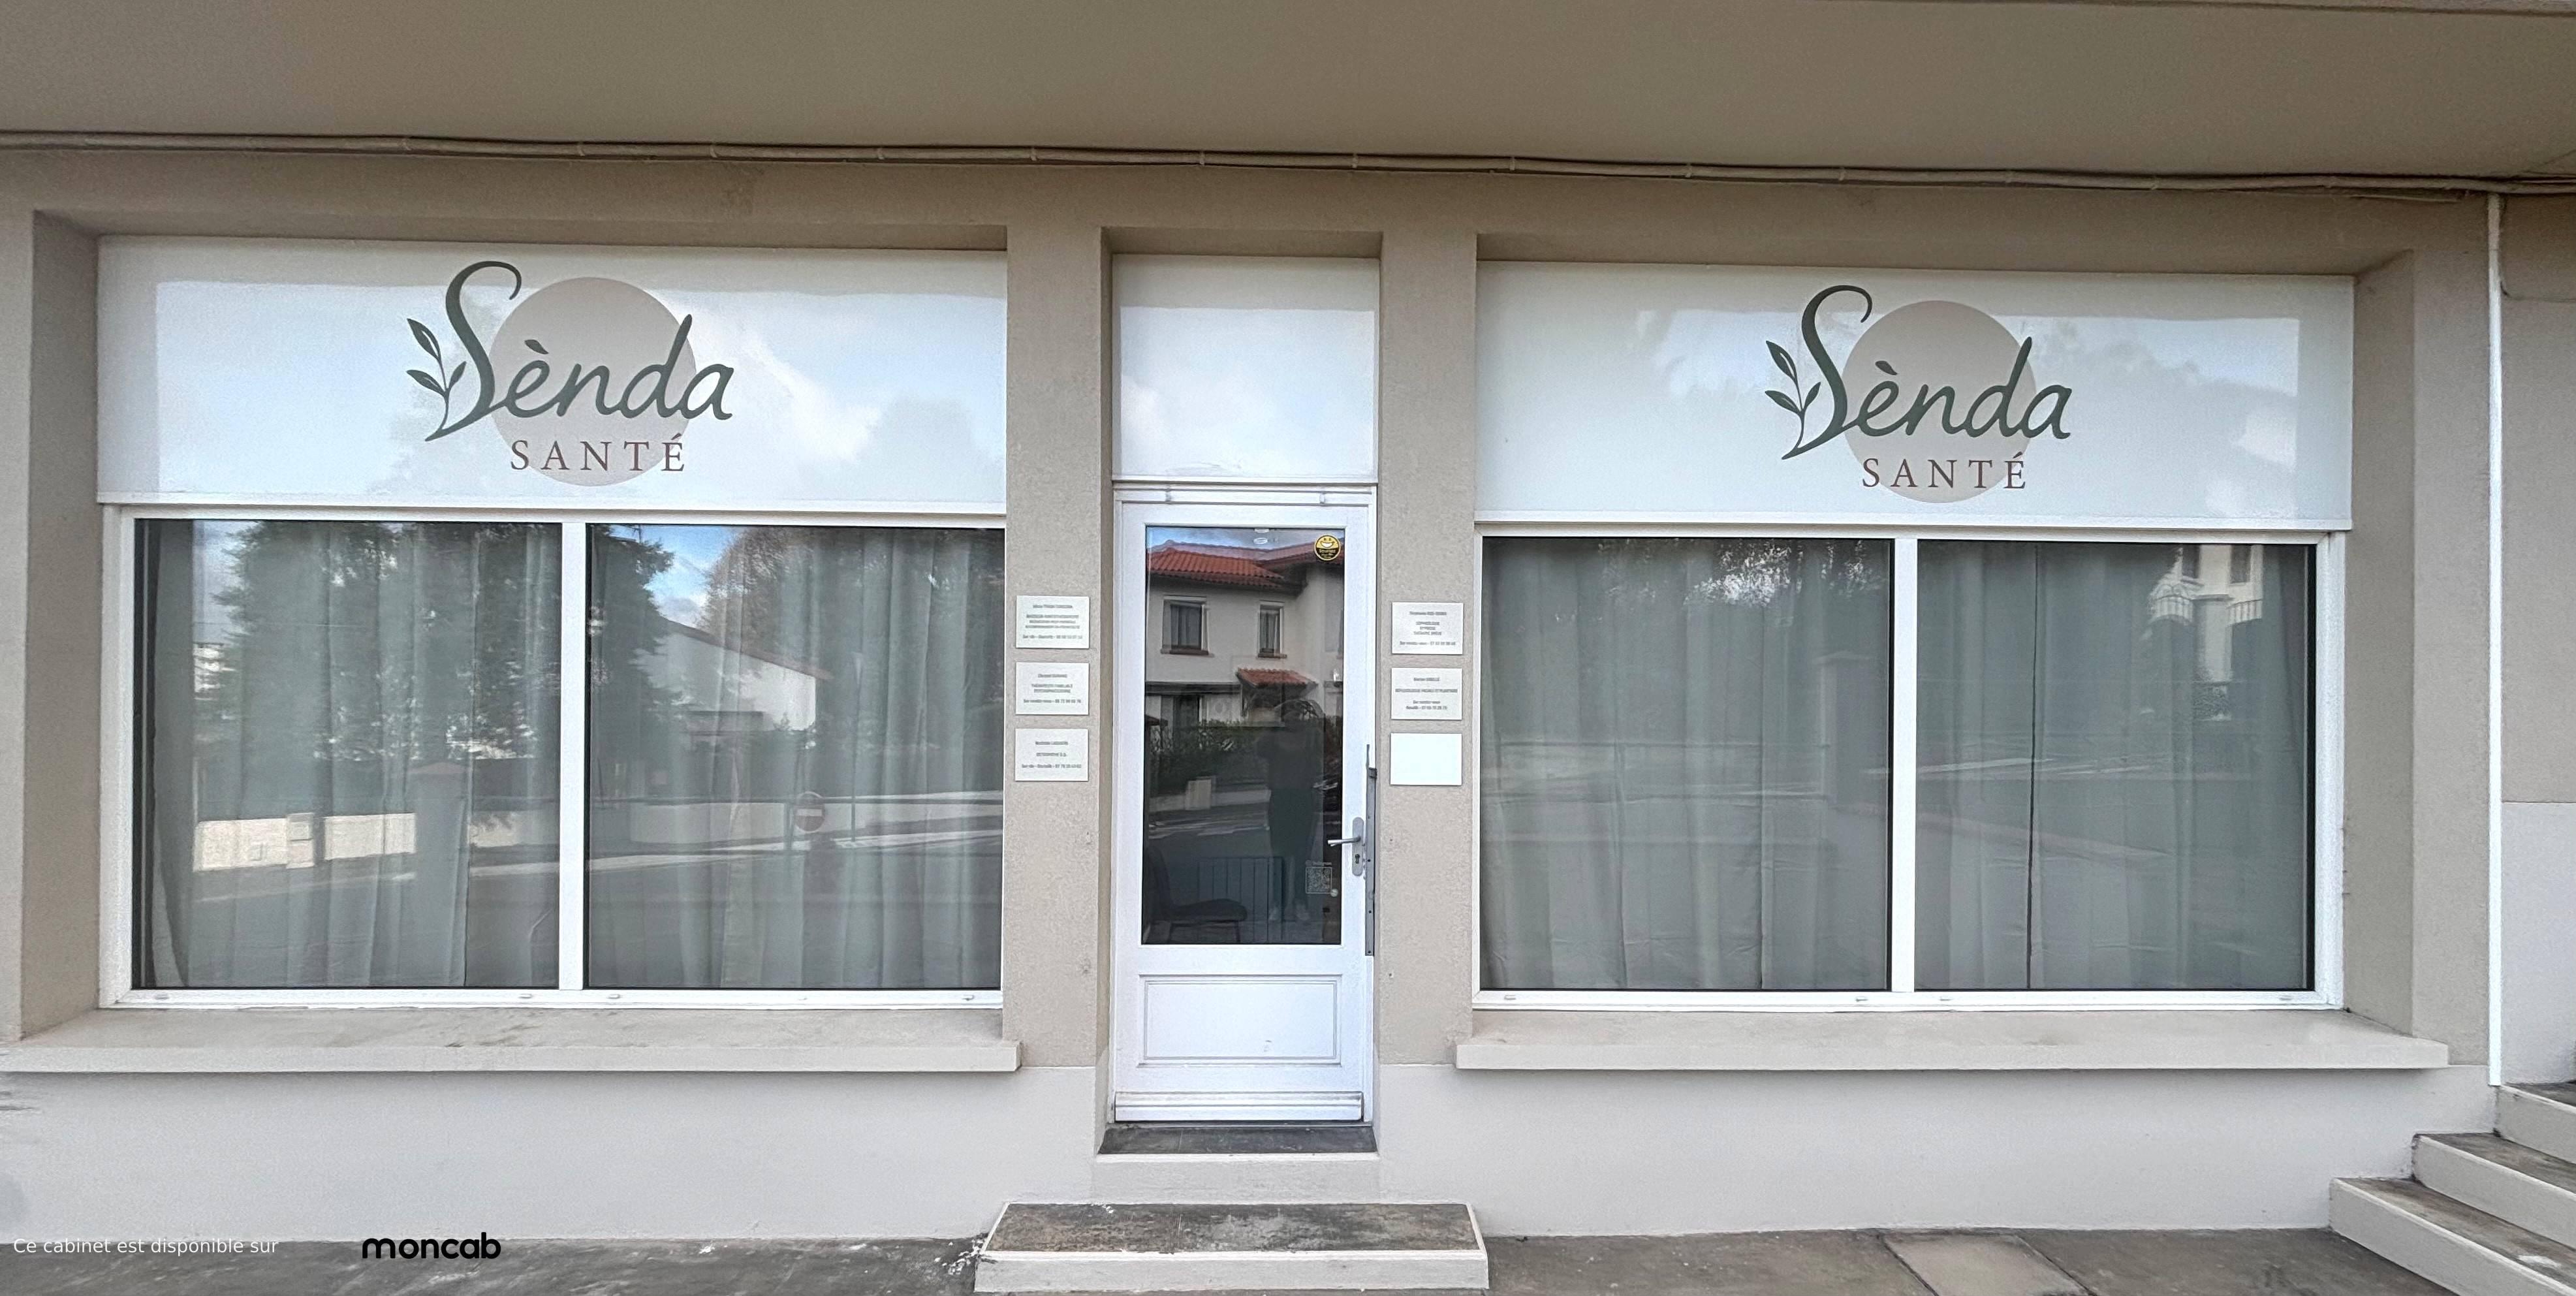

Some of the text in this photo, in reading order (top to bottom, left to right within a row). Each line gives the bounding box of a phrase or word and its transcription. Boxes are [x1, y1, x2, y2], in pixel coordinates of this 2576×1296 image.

[425, 261, 733, 441] Sènda
[1782, 285, 2072, 460] Sènda
[510, 433, 685, 471] SANTÉ
[1862, 451, 2026, 489] SANTÉ
